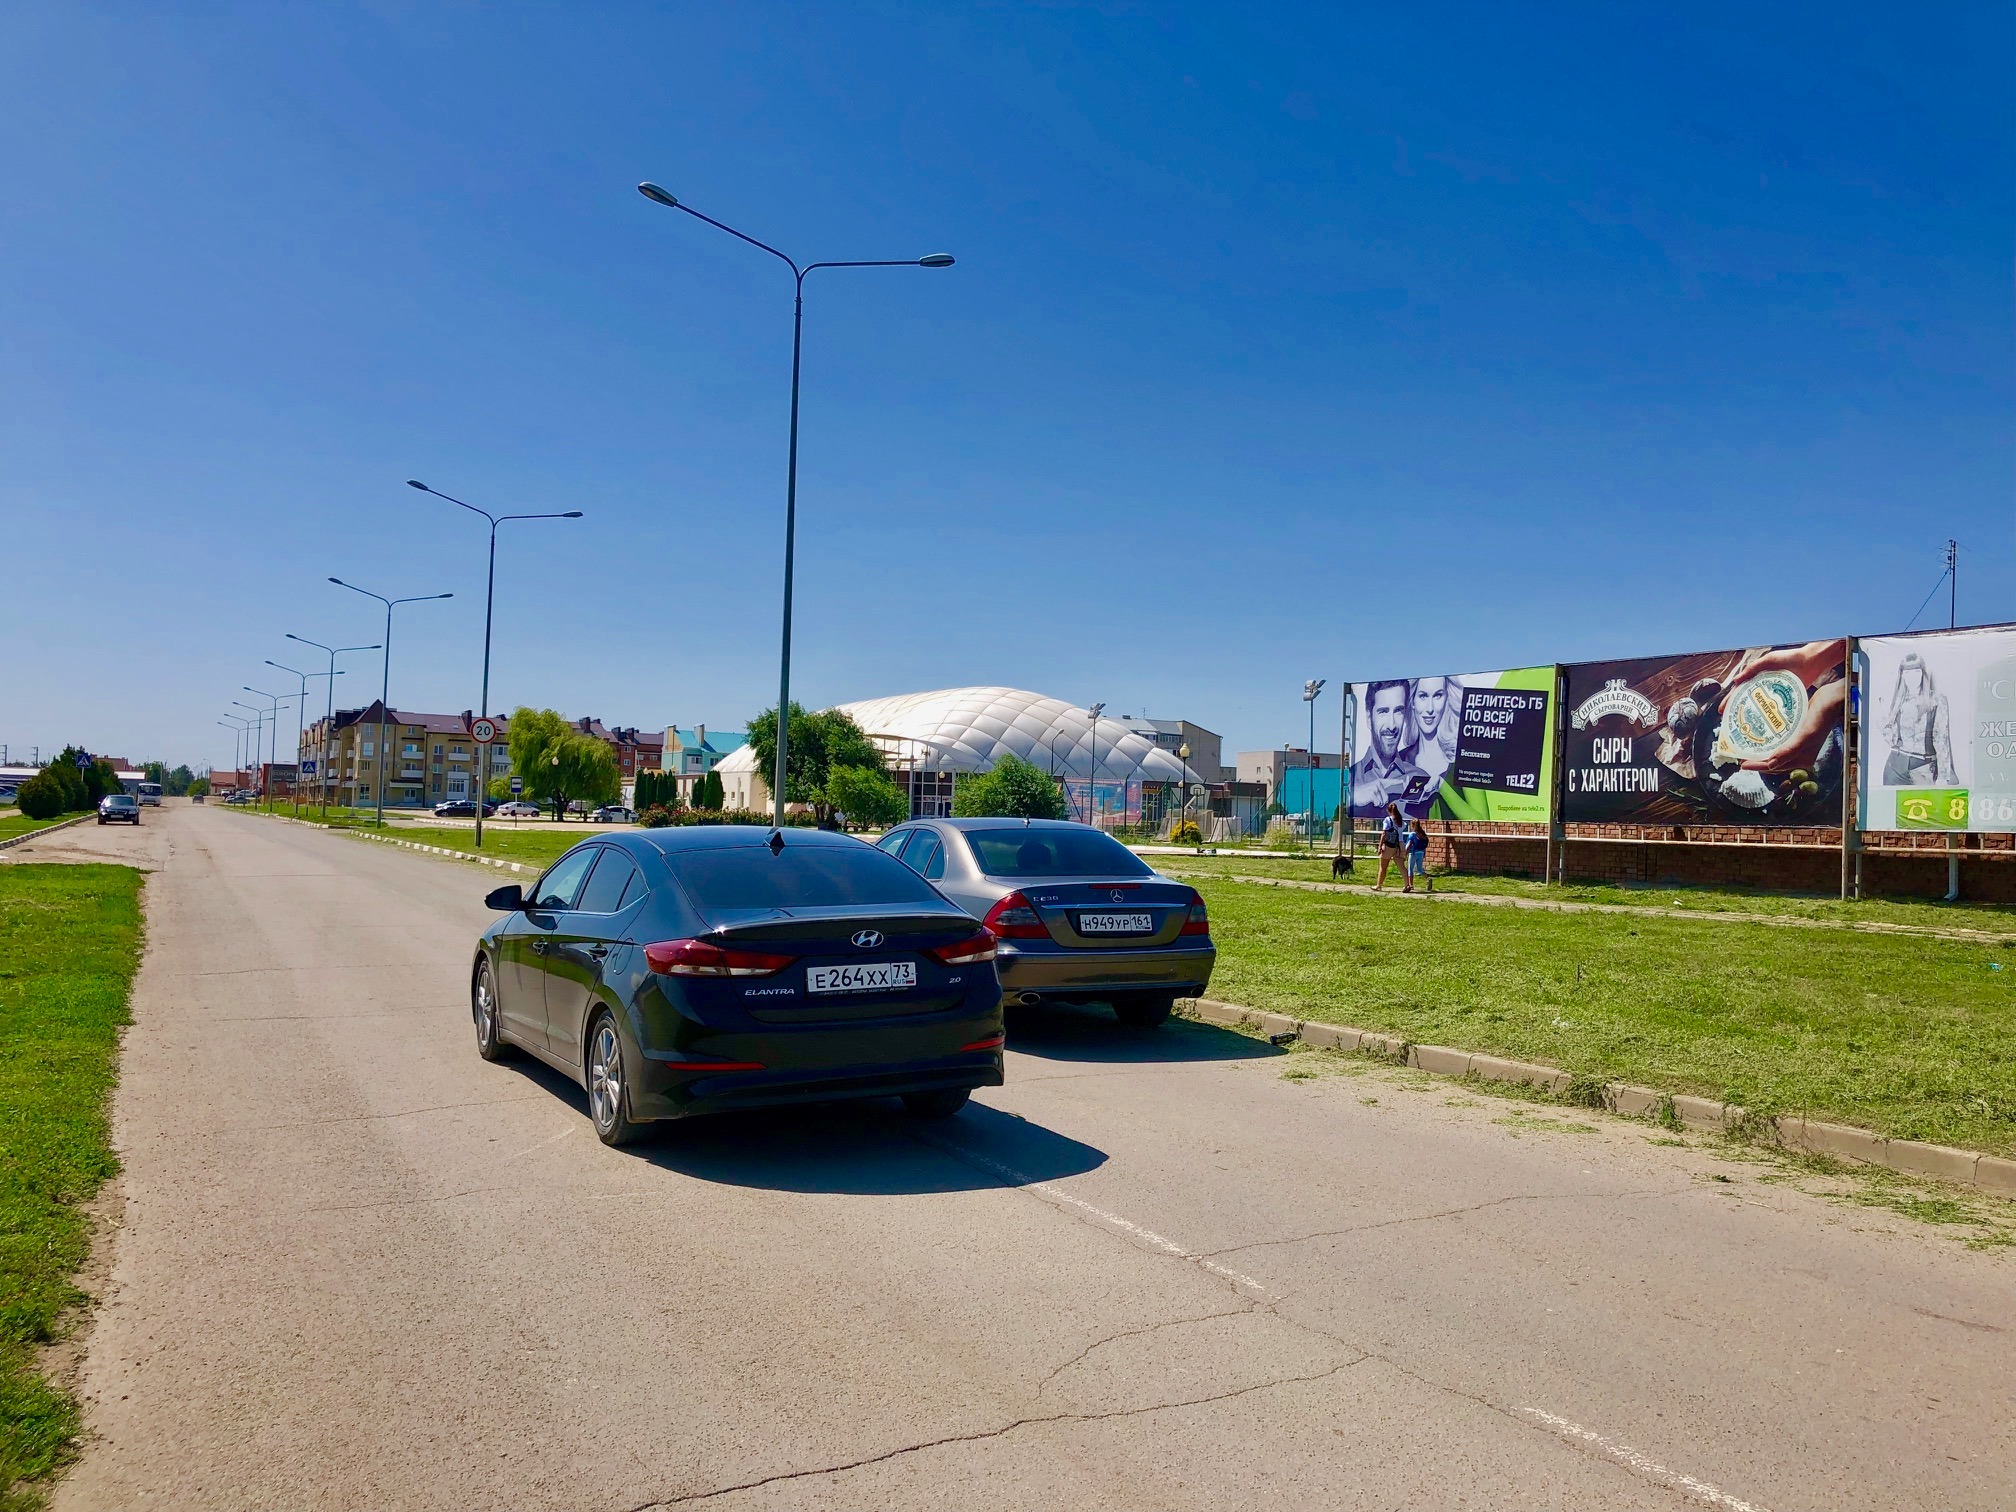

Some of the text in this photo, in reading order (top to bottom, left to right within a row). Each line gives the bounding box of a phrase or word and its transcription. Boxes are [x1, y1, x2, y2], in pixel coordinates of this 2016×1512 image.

[1982, 679, 2016, 700] "С
[1465, 693, 1543, 710] ДЕЛИТЕСЬ ГБ
[1581, 692, 1649, 717] НИКОЛАЕВСКИЕ
[1594, 703, 1634, 716] СЫРОВАРНИ
[1464, 709, 1514, 724] ПО ВСЕЙ
[476, 725, 491, 736] 20
[1463, 724, 1507, 740] СТРАНЕ
[1592, 737, 1632, 764] СЫРЫ
[1505, 773, 1535, 789] TELE2
[1568, 767, 1659, 792] С ХАРАКТЕРОМ
[815, 964, 910, 989] Е264ХХ 73
[744, 988, 795, 996] ELANTRA
